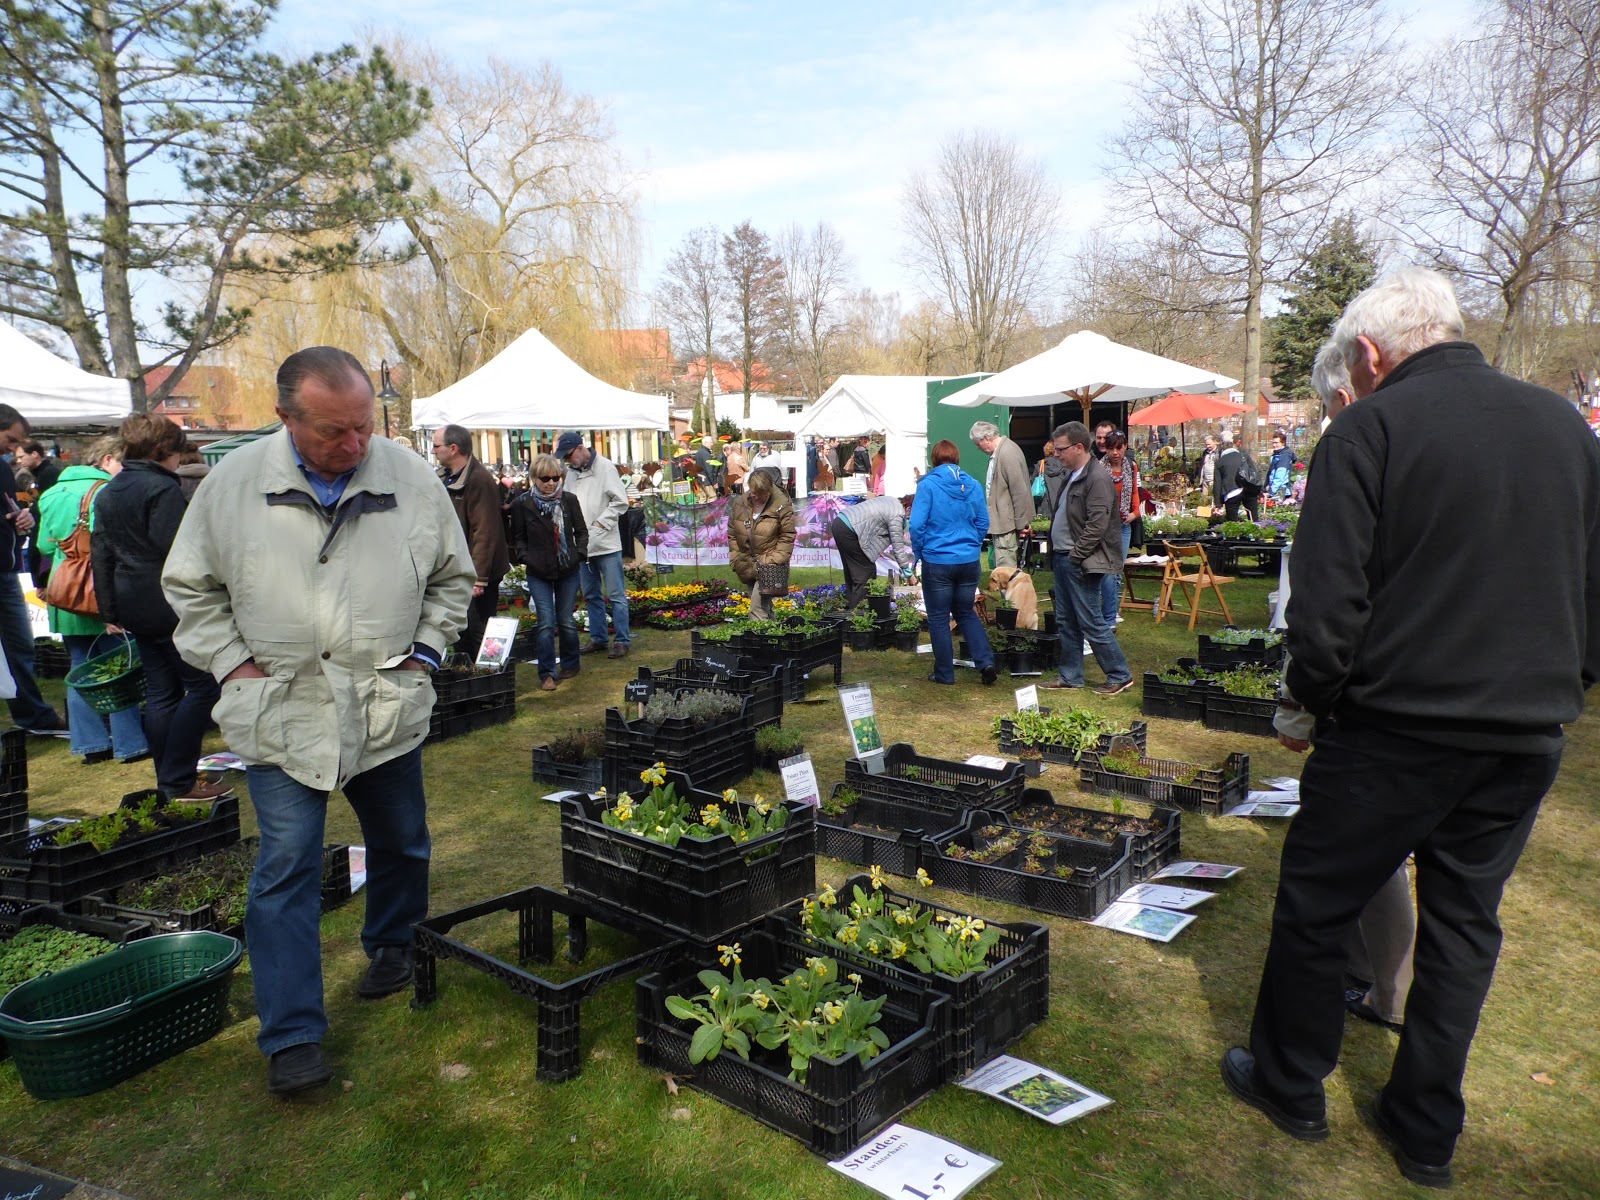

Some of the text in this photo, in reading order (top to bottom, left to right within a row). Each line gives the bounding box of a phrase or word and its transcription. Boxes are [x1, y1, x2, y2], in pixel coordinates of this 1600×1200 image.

[661, 549, 699, 560] Stauden
[710, 549, 730, 560] Dau
[790, 550, 829, 564] npracht
[844, 1133, 902, 1170] Stauden
[867, 1142, 909, 1171] (winterhart)
[944, 1153, 969, 1169] €
